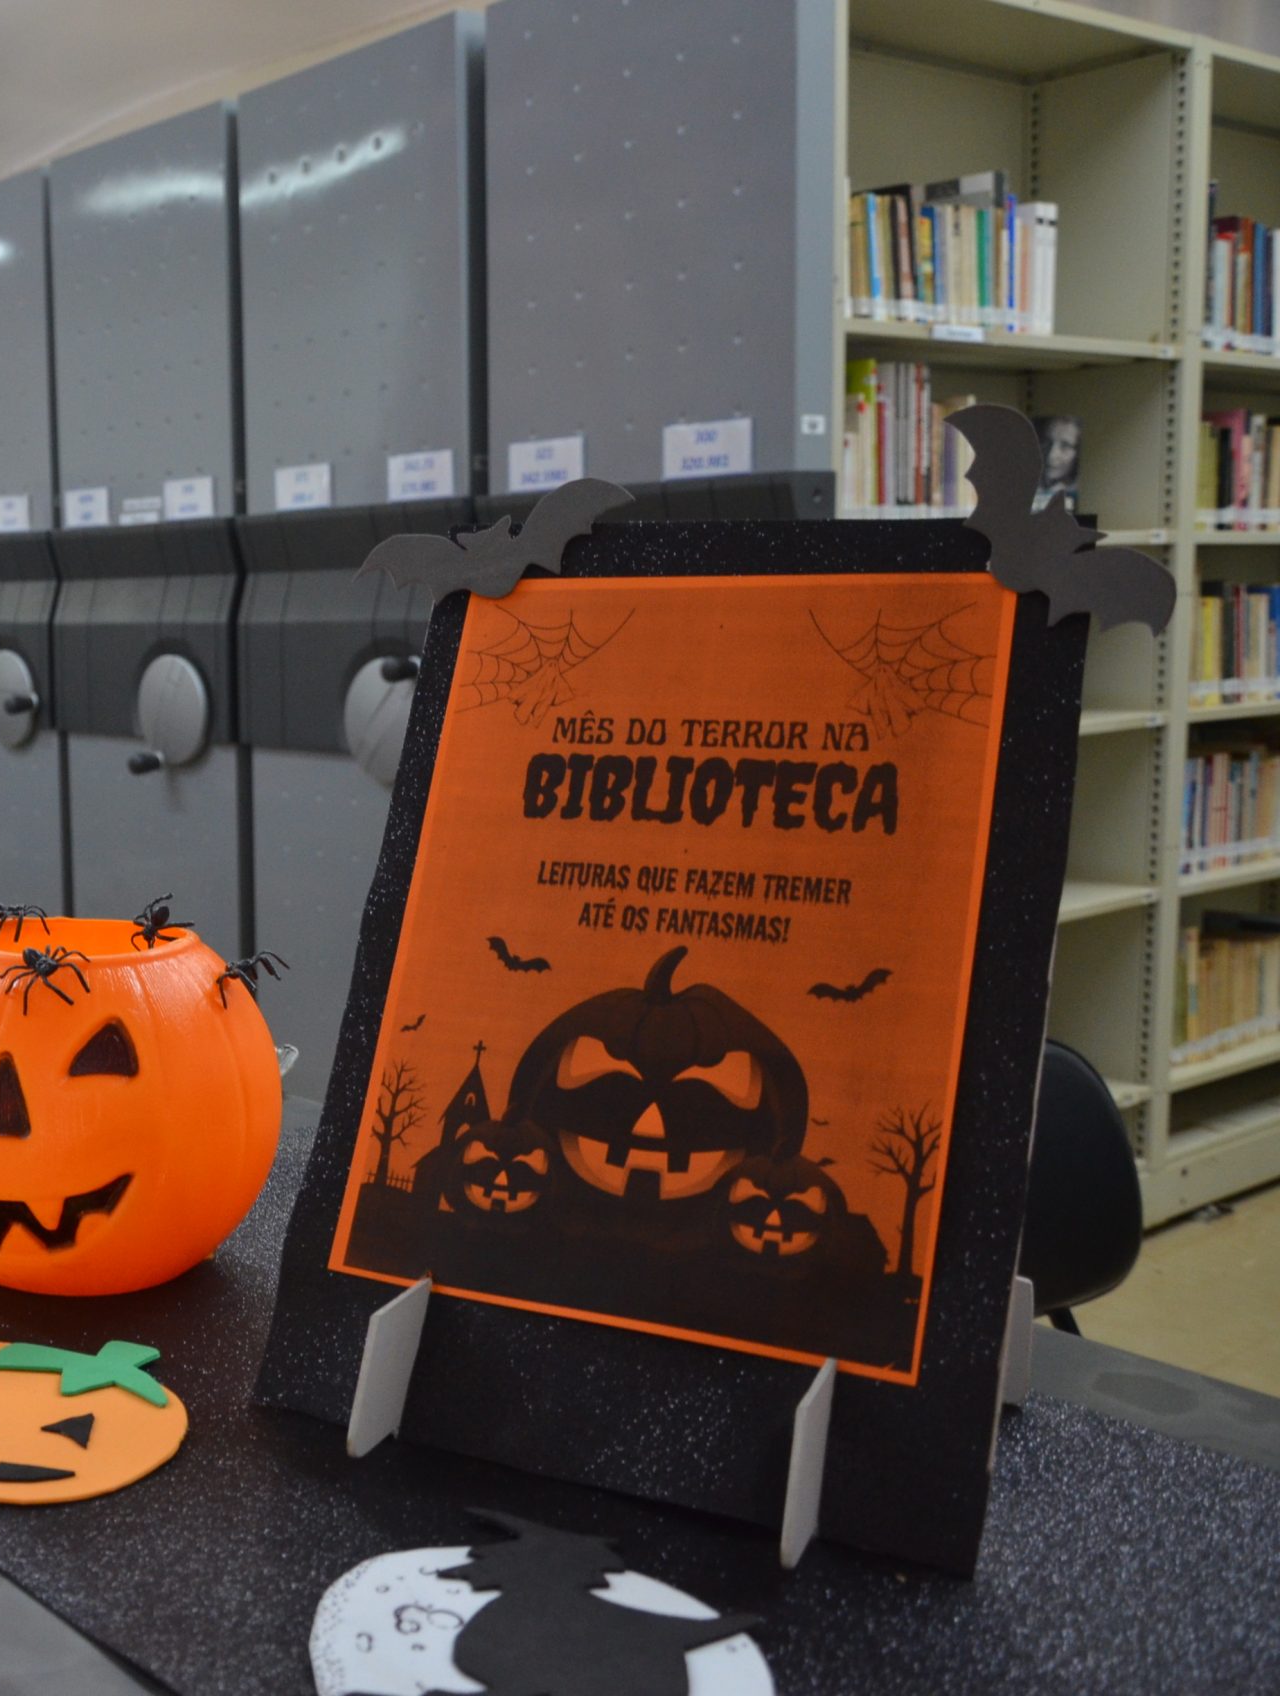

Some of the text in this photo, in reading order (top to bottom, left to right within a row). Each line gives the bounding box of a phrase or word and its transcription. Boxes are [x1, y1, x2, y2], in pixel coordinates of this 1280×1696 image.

[552, 710, 870, 752] MÊS DO TERROR NA
[522, 753, 899, 836] BIBLIOTECA
[537, 860, 852, 906] LEITURAS QUE FAZEM TREMER
[578, 898, 792, 943] ATÉ OS FANTASMAS!
